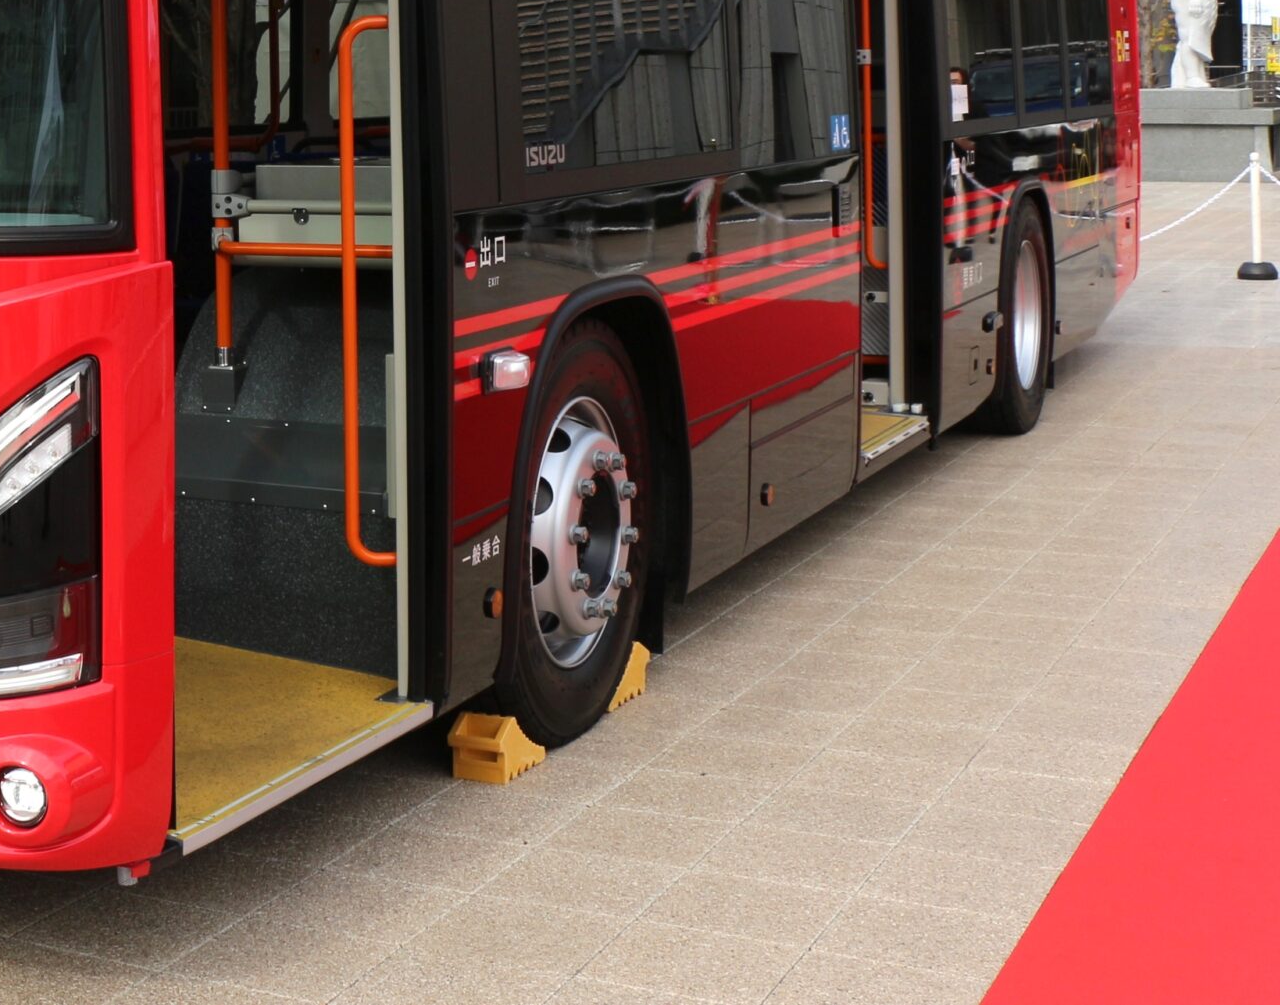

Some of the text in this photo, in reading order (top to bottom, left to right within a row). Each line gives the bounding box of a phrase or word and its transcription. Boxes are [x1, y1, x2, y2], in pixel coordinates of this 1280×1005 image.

[525, 144, 566, 168] ISUZU
[479, 235, 506, 268] 出口
[487, 276, 500, 288] EXIT
